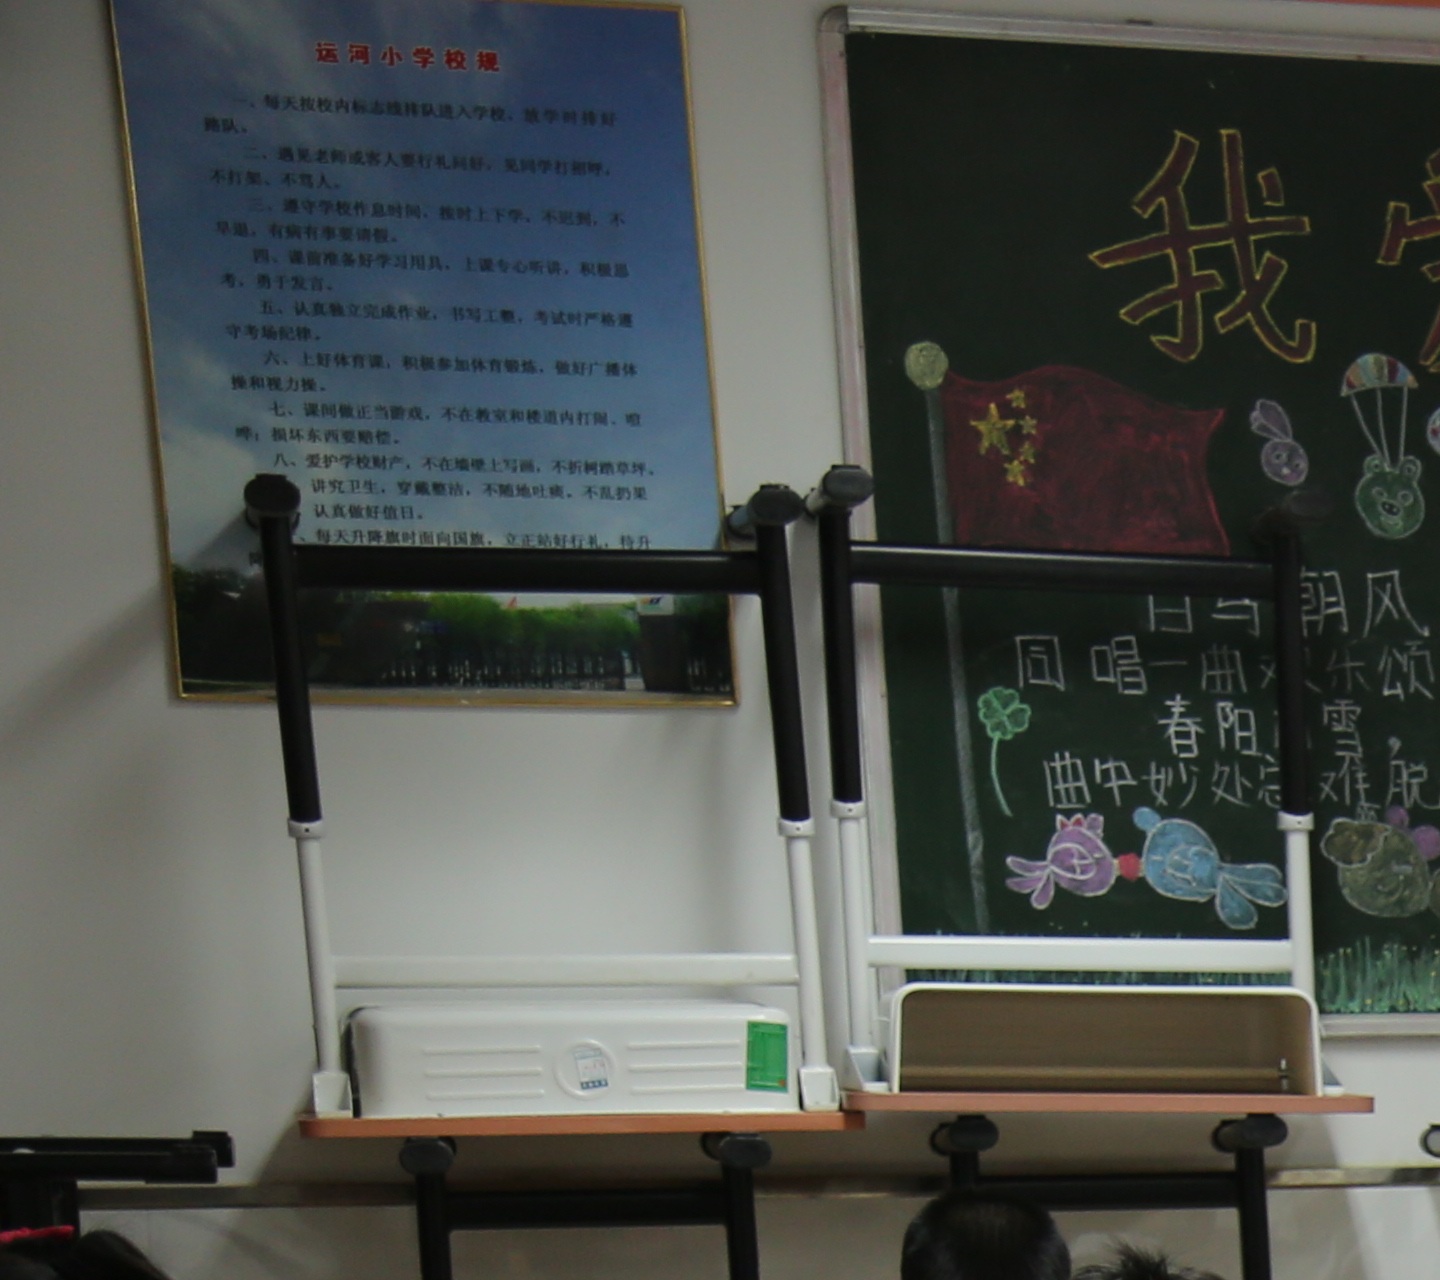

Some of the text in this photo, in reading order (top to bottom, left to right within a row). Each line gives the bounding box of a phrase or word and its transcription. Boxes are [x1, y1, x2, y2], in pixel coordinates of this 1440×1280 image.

[314, 41, 503, 74] 运河小学校规
